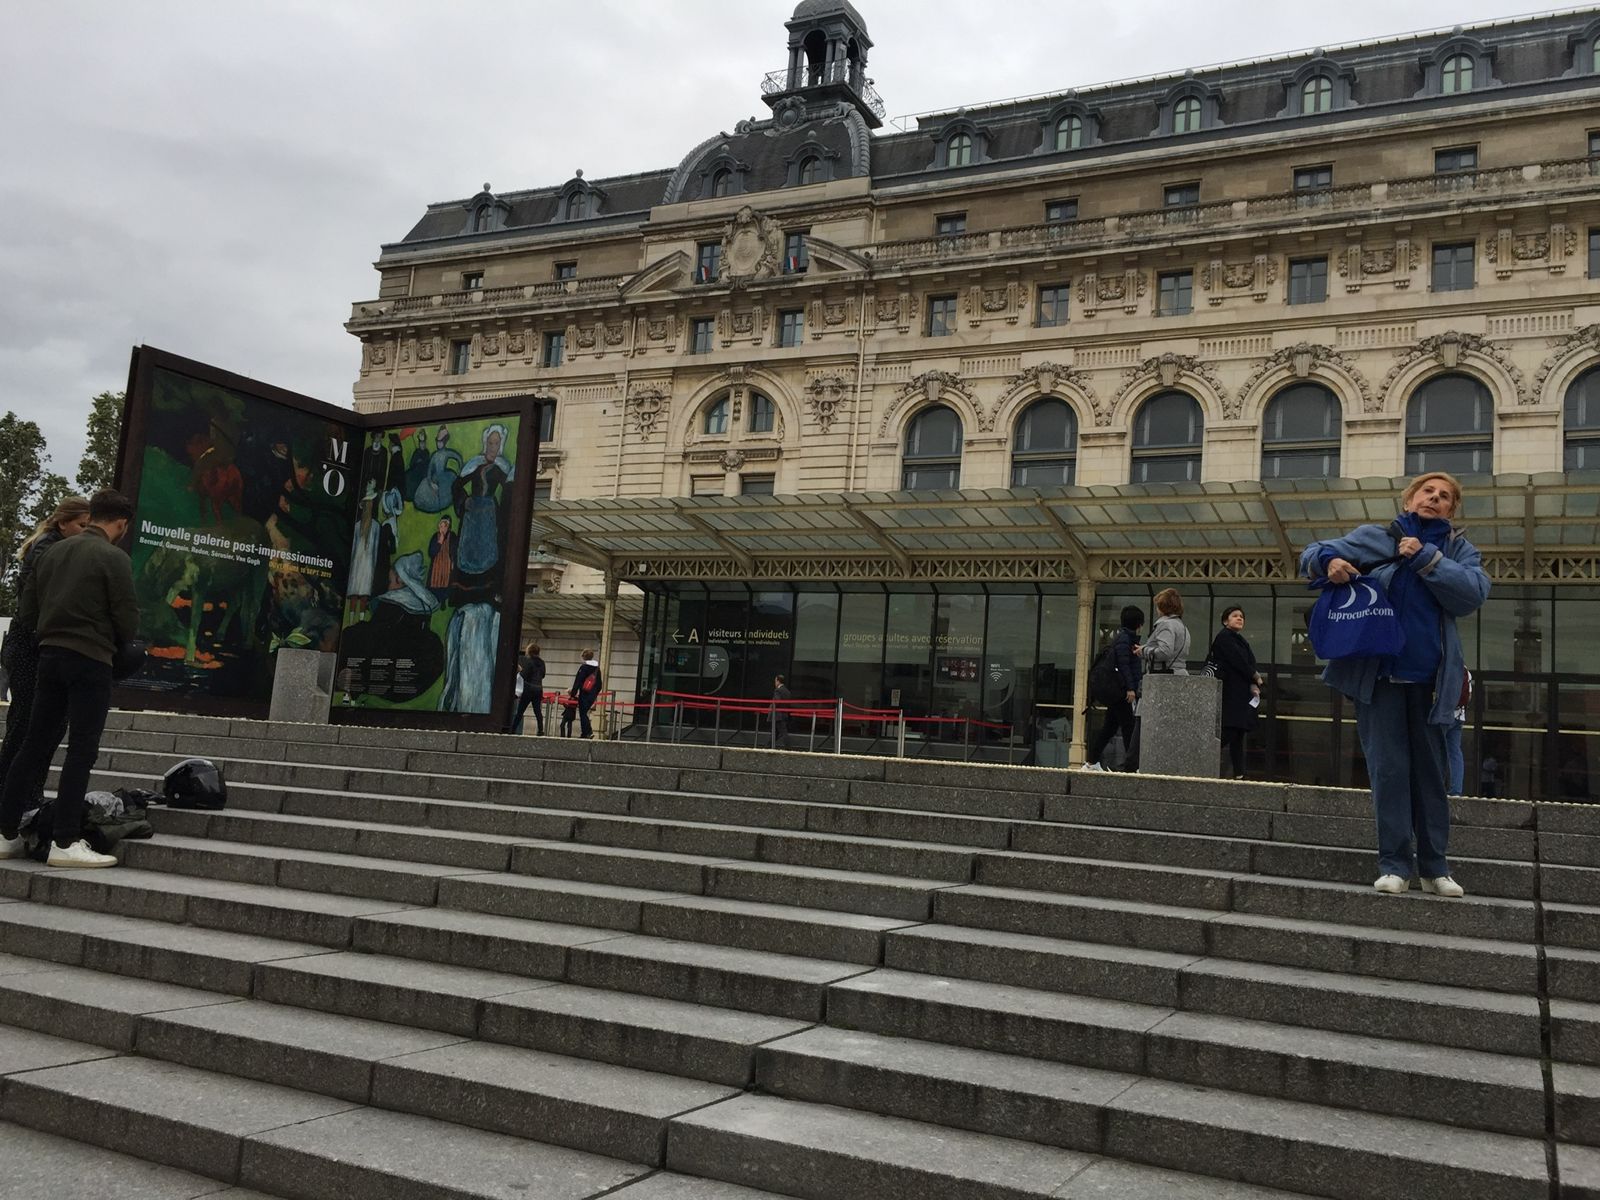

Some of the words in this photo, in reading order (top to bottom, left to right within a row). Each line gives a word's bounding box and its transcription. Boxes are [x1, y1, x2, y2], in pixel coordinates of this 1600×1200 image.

[328, 437, 348, 464] M
[139, 536, 165, 548] Bernard,
[141, 520, 191, 541] Nouvelle
[193, 533, 231, 549] galerie
[232, 541, 334, 569] post-impressionniste
[1328, 607, 1394, 622] laprocure.com
[687, 628, 699, 643] A
[708, 628, 741, 638] visiteurs
[744, 629, 790, 640] individuels
[843, 633, 876, 644] groupes
[935, 634, 983, 645] réservation
